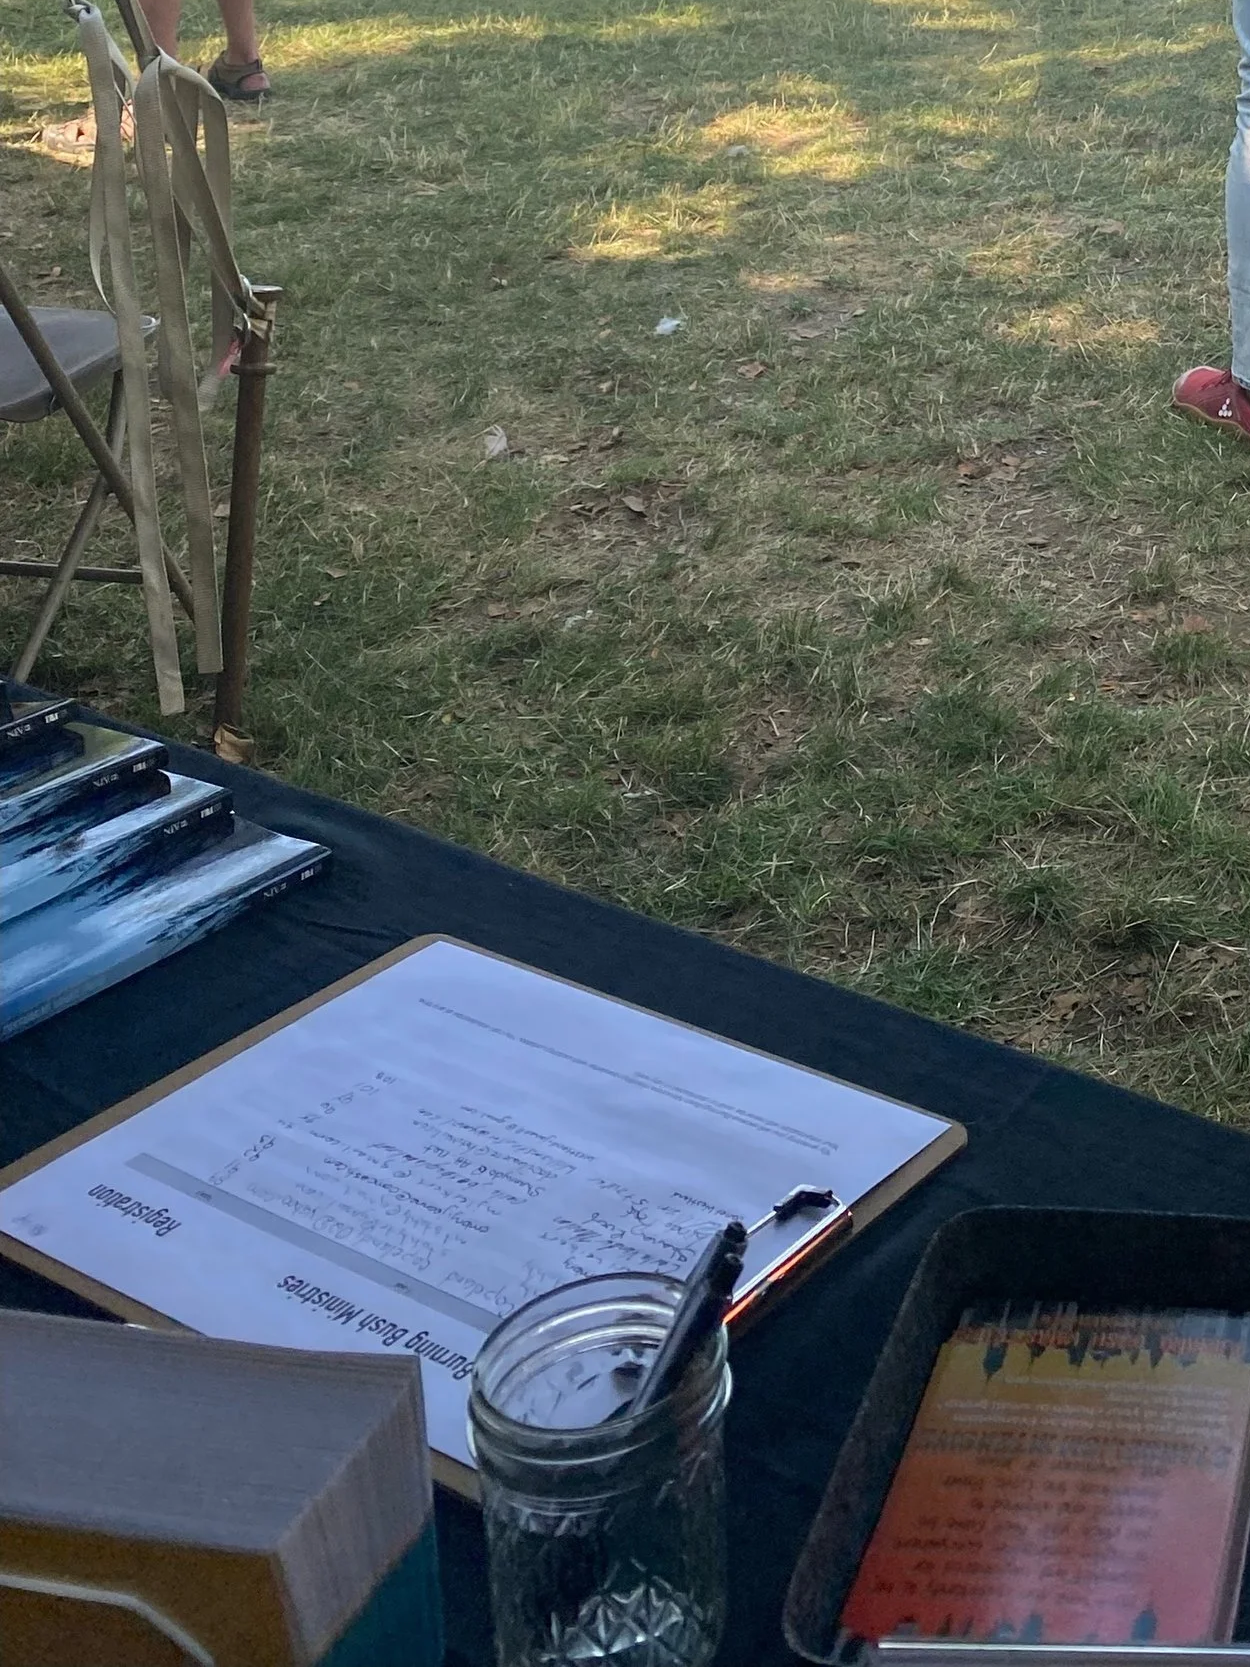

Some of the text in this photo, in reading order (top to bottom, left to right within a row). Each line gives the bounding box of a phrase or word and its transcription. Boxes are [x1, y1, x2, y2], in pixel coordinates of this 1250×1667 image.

[87, 1183, 182, 1238] Registration
[276, 1275, 477, 1381] Burning Bush Ministries
